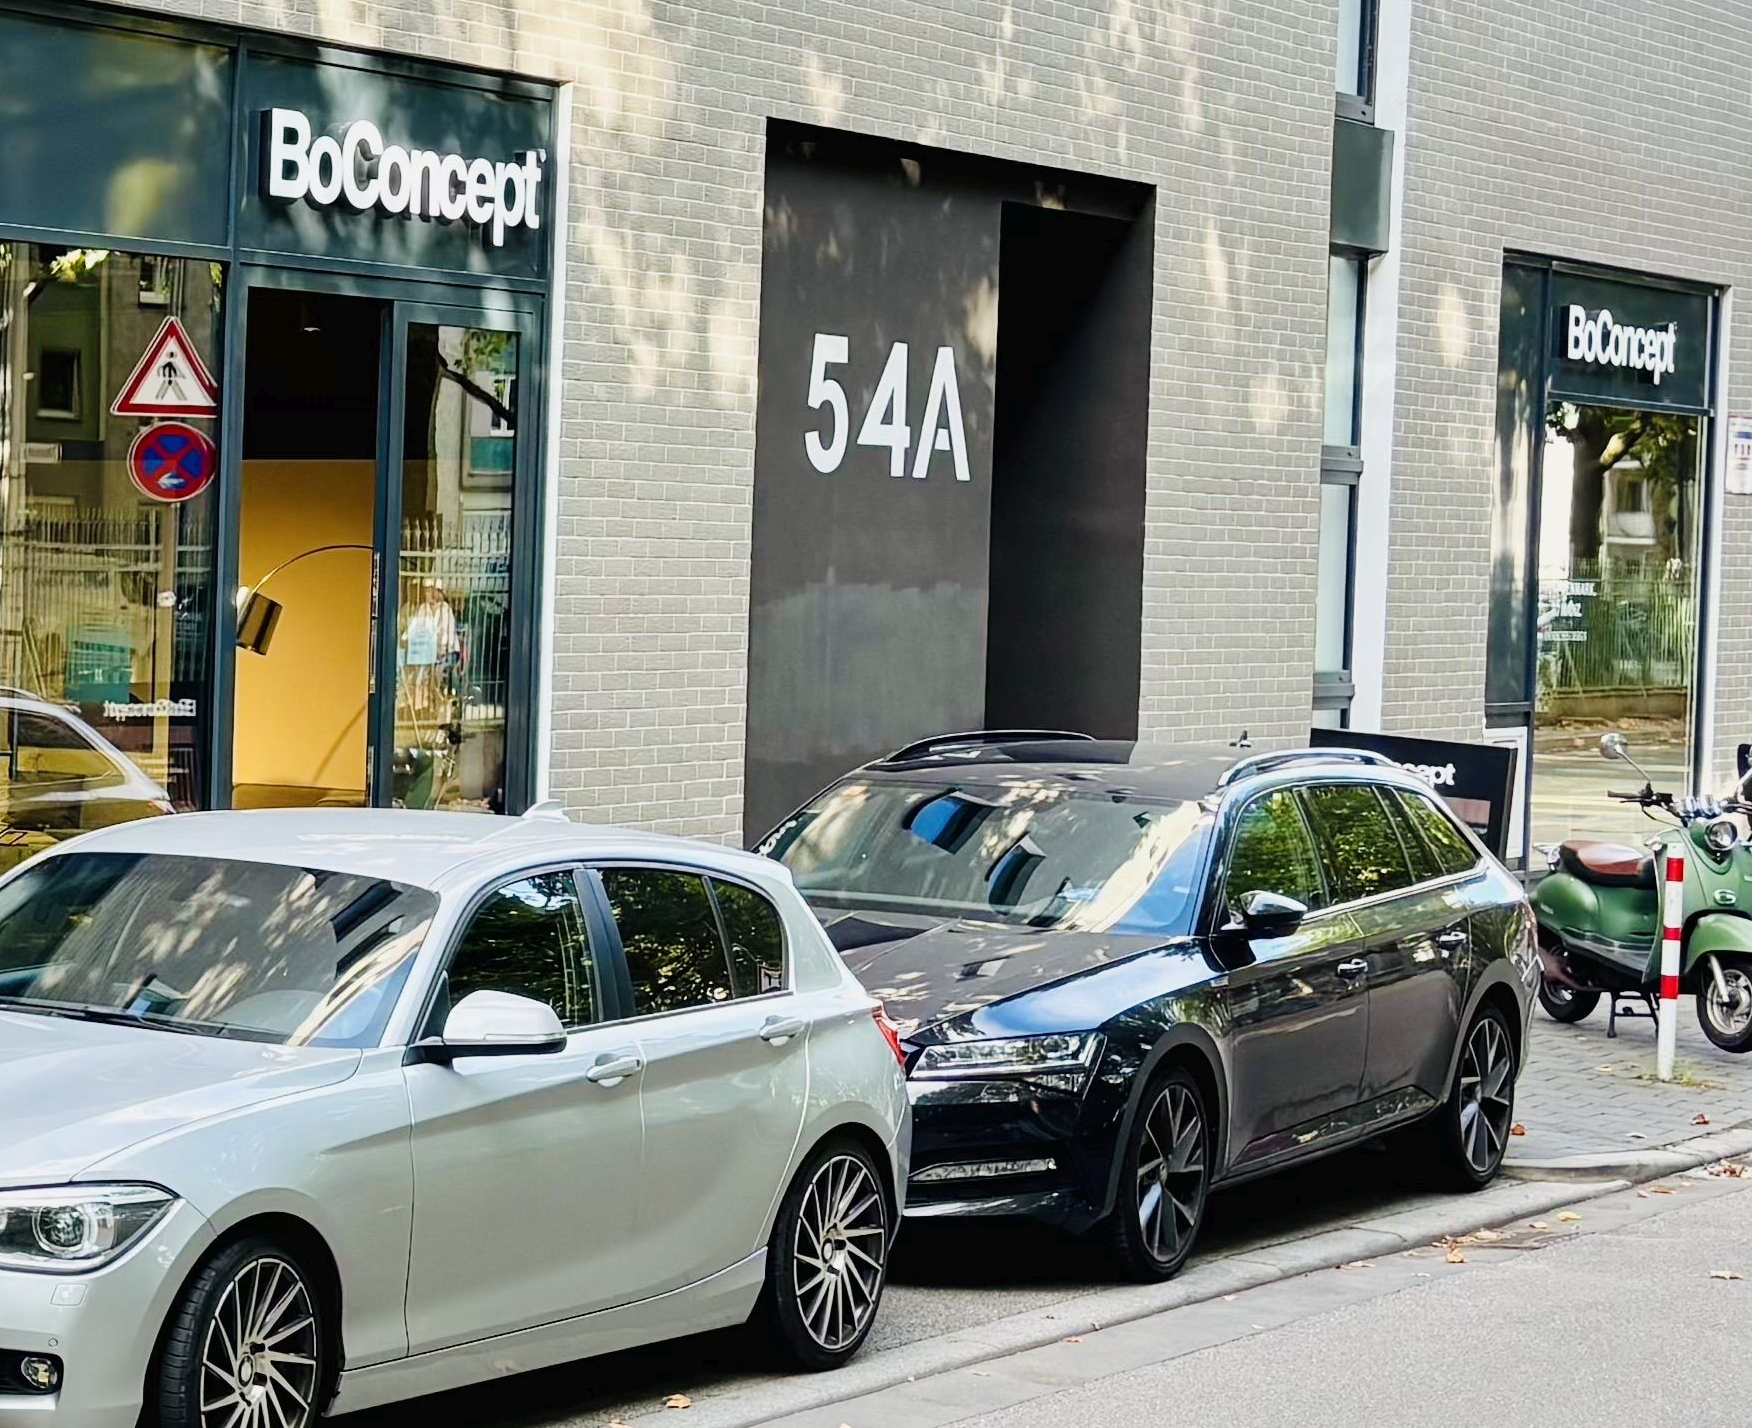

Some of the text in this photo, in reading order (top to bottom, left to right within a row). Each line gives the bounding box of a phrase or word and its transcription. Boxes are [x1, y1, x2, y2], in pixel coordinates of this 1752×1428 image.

[268, 106, 542, 247] BoConcept
[804, 332, 971, 482] 54A
[1567, 303, 1677, 386] BoConcept
